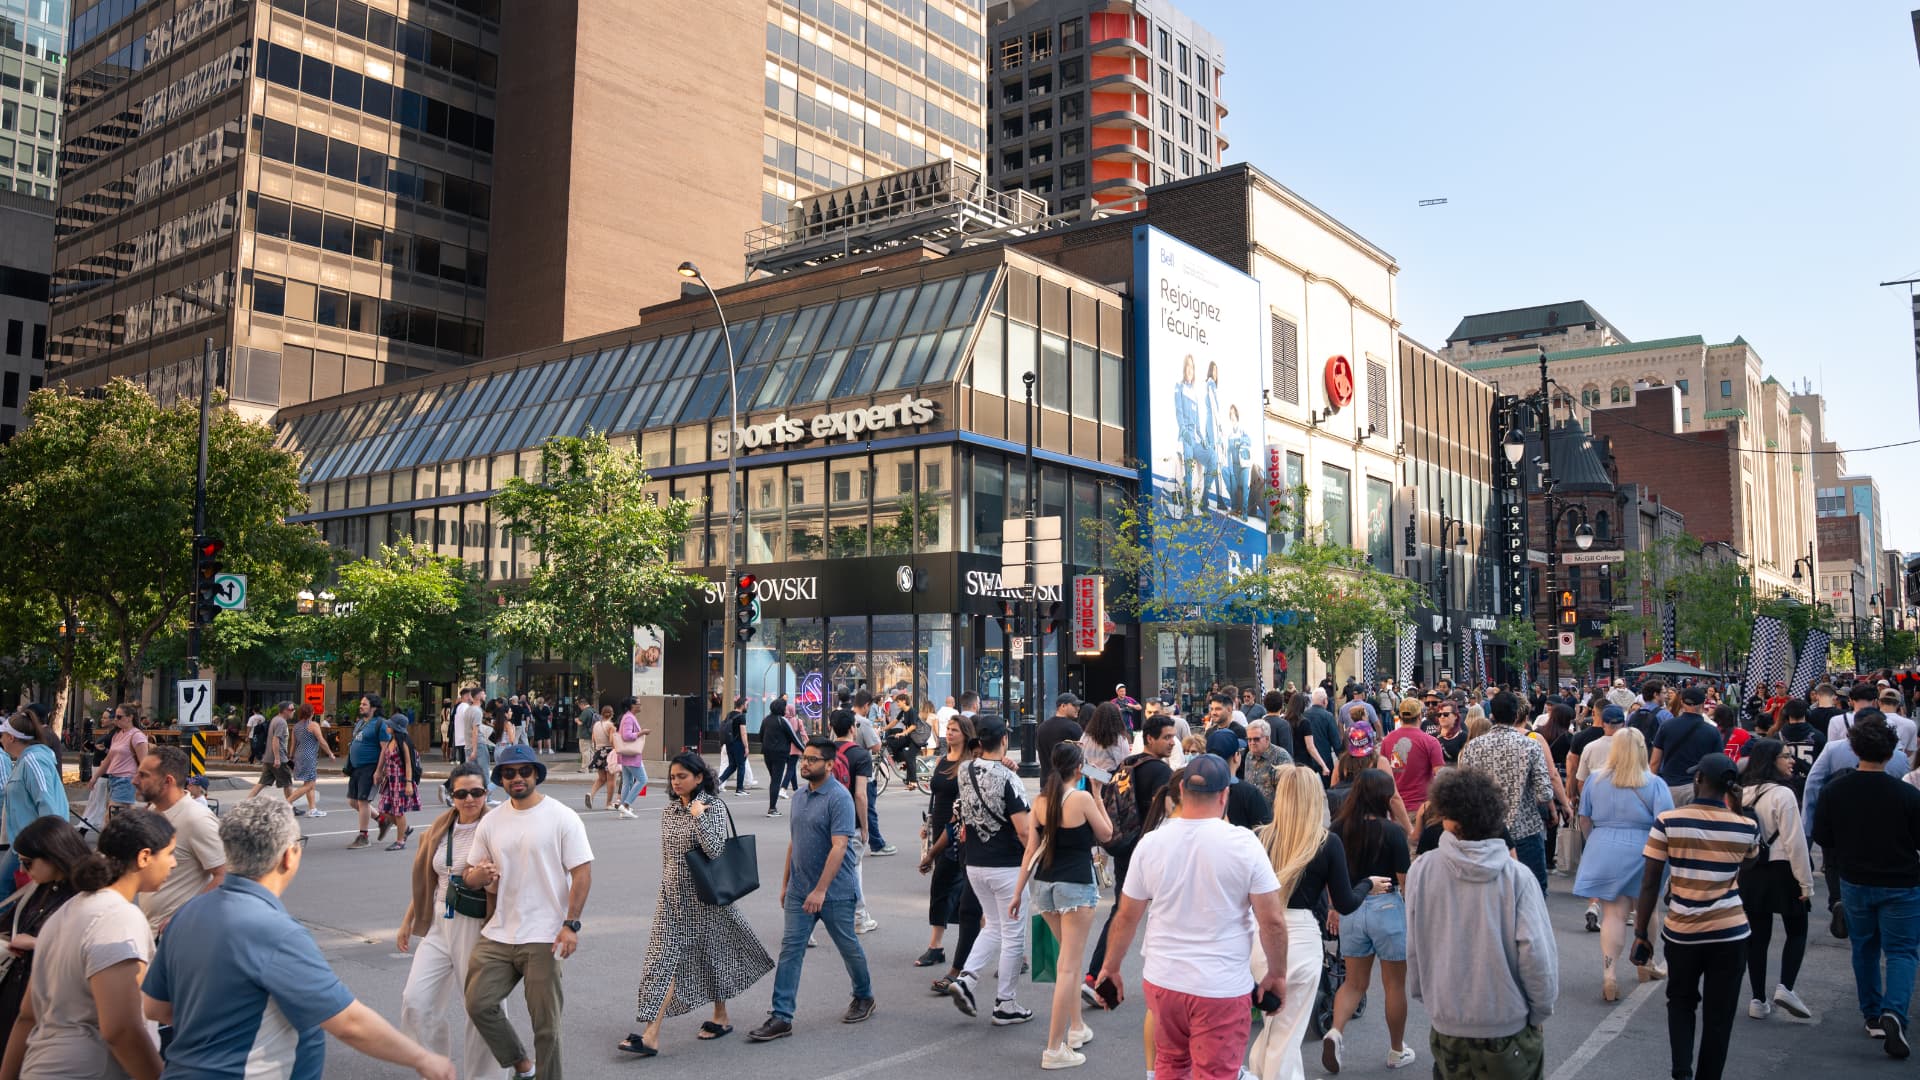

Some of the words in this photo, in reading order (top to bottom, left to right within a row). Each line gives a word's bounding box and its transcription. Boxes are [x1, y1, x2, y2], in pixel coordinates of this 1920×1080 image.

[1160, 248, 1175, 267] Bell
[1160, 278, 1221, 322] Rejoignez
[1161, 307, 1209, 346] l'écurie.
[713, 413, 805, 456] sports
[810, 394, 934, 440] experts
[1511, 505, 1522, 612] experts
[1595, 554, 1621, 562] College
[1082, 578, 1097, 648] REUBEN'S
